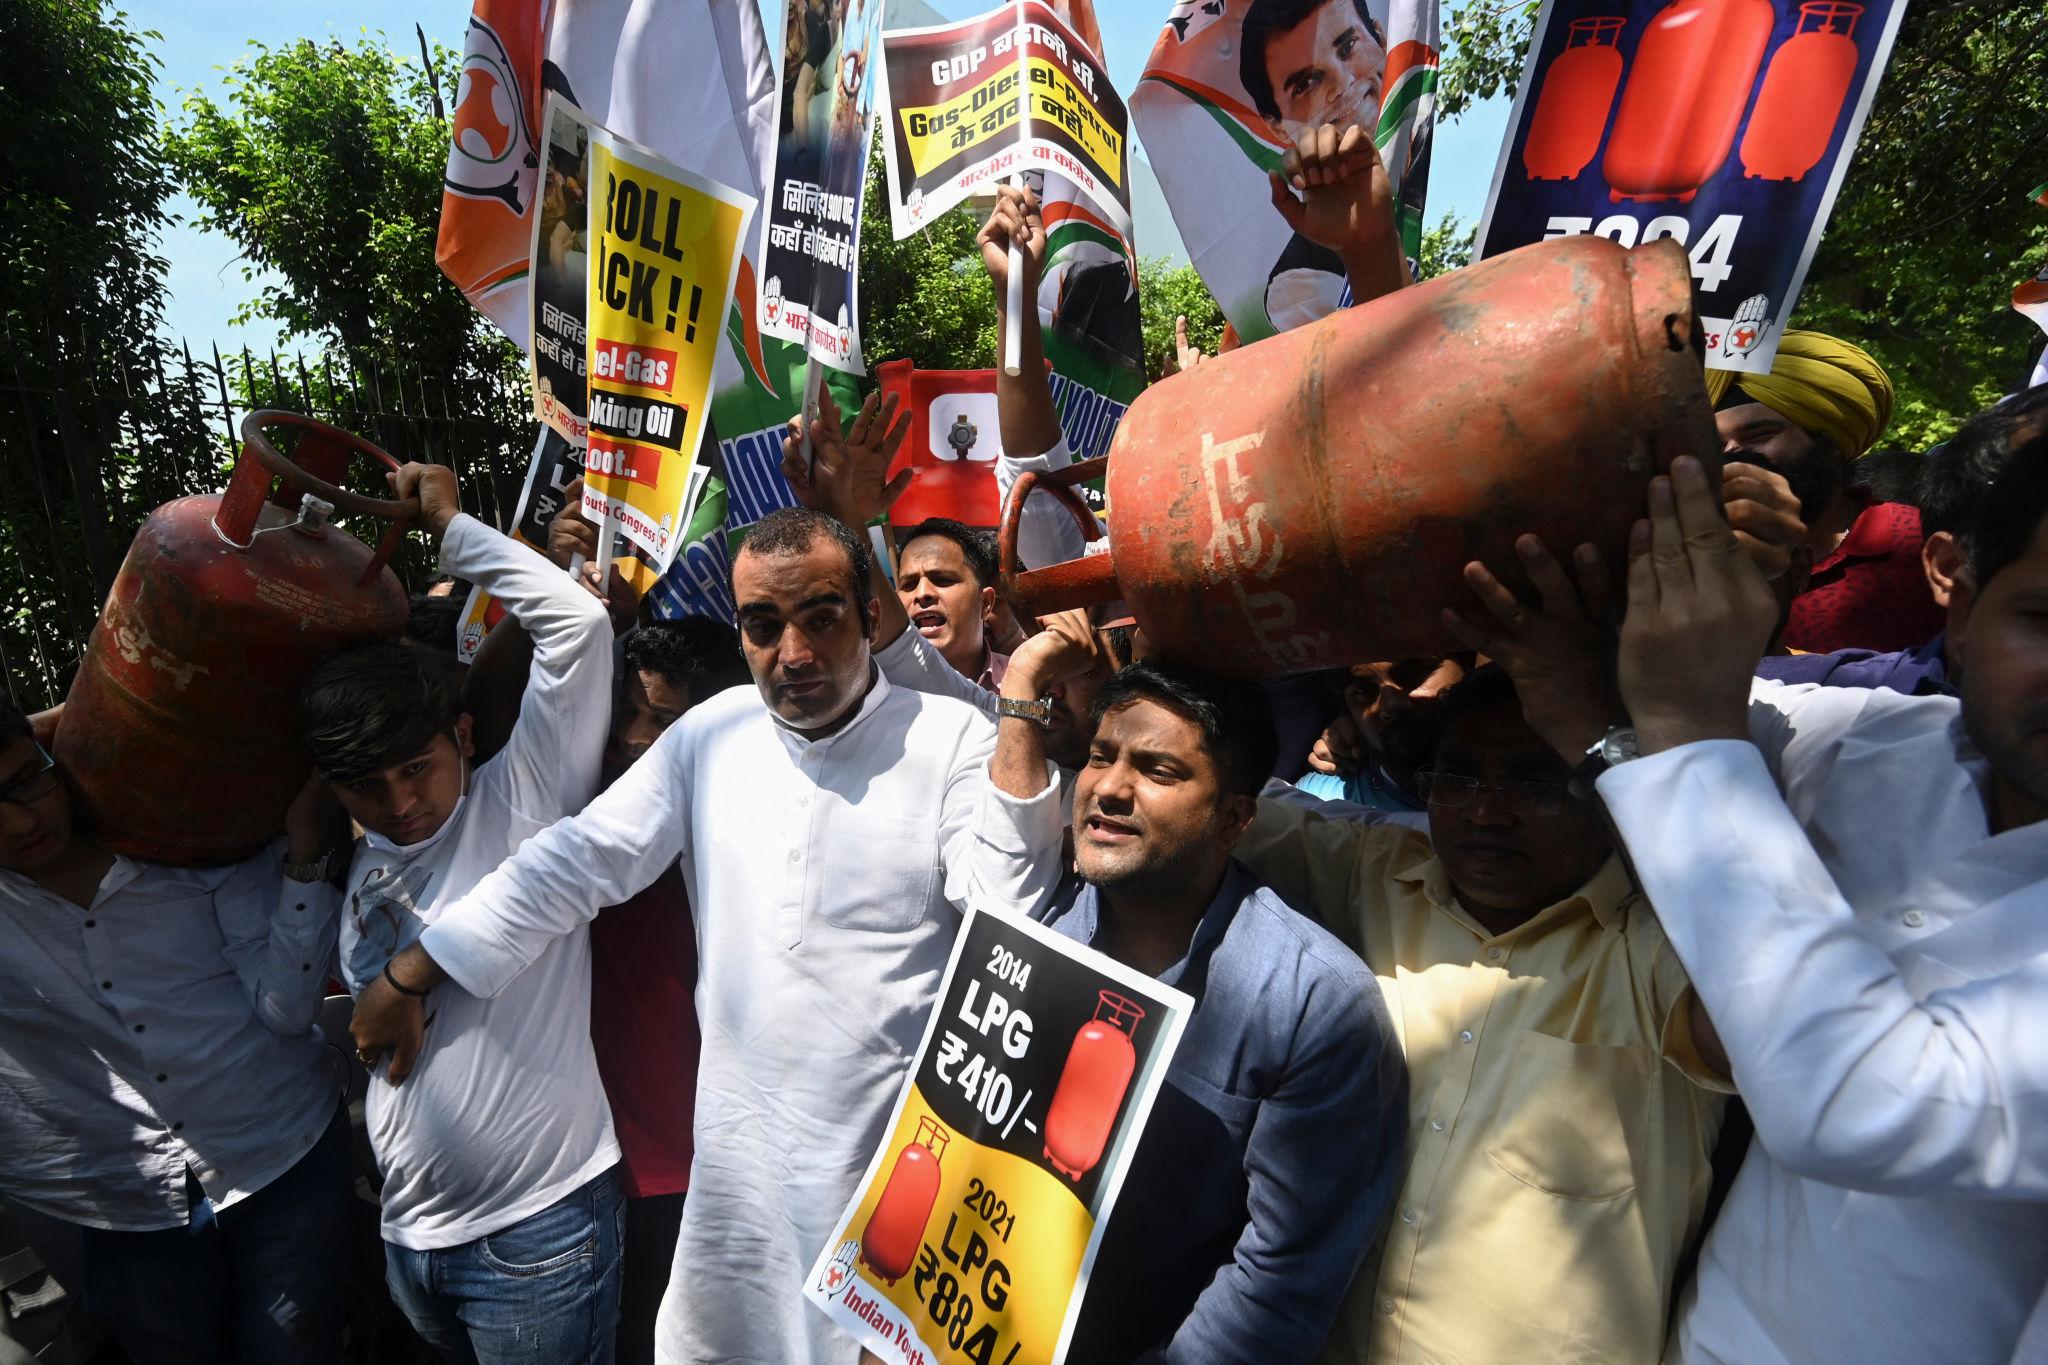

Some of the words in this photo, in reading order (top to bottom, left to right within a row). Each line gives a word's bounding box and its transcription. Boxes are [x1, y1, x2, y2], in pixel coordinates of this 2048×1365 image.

[931, 46, 987, 86] GDP
[951, 123, 975, 150] के
[770, 219, 804, 252] कहाँ
[536, 332, 561, 363] कहाँ
[561, 347, 576, 372] हो
[646, 403, 674, 439] Oil
[613, 505, 656, 543] Congress
[986, 944, 1032, 992] 2014
[958, 979, 1033, 1060] LPG
[935, 1029, 1037, 1141] ₹410/-
[963, 1178, 1017, 1244] 2021
[940, 1213, 1012, 1313] LPG
[842, 1285, 894, 1338] Indian
[894, 1323, 925, 1365] Youth
